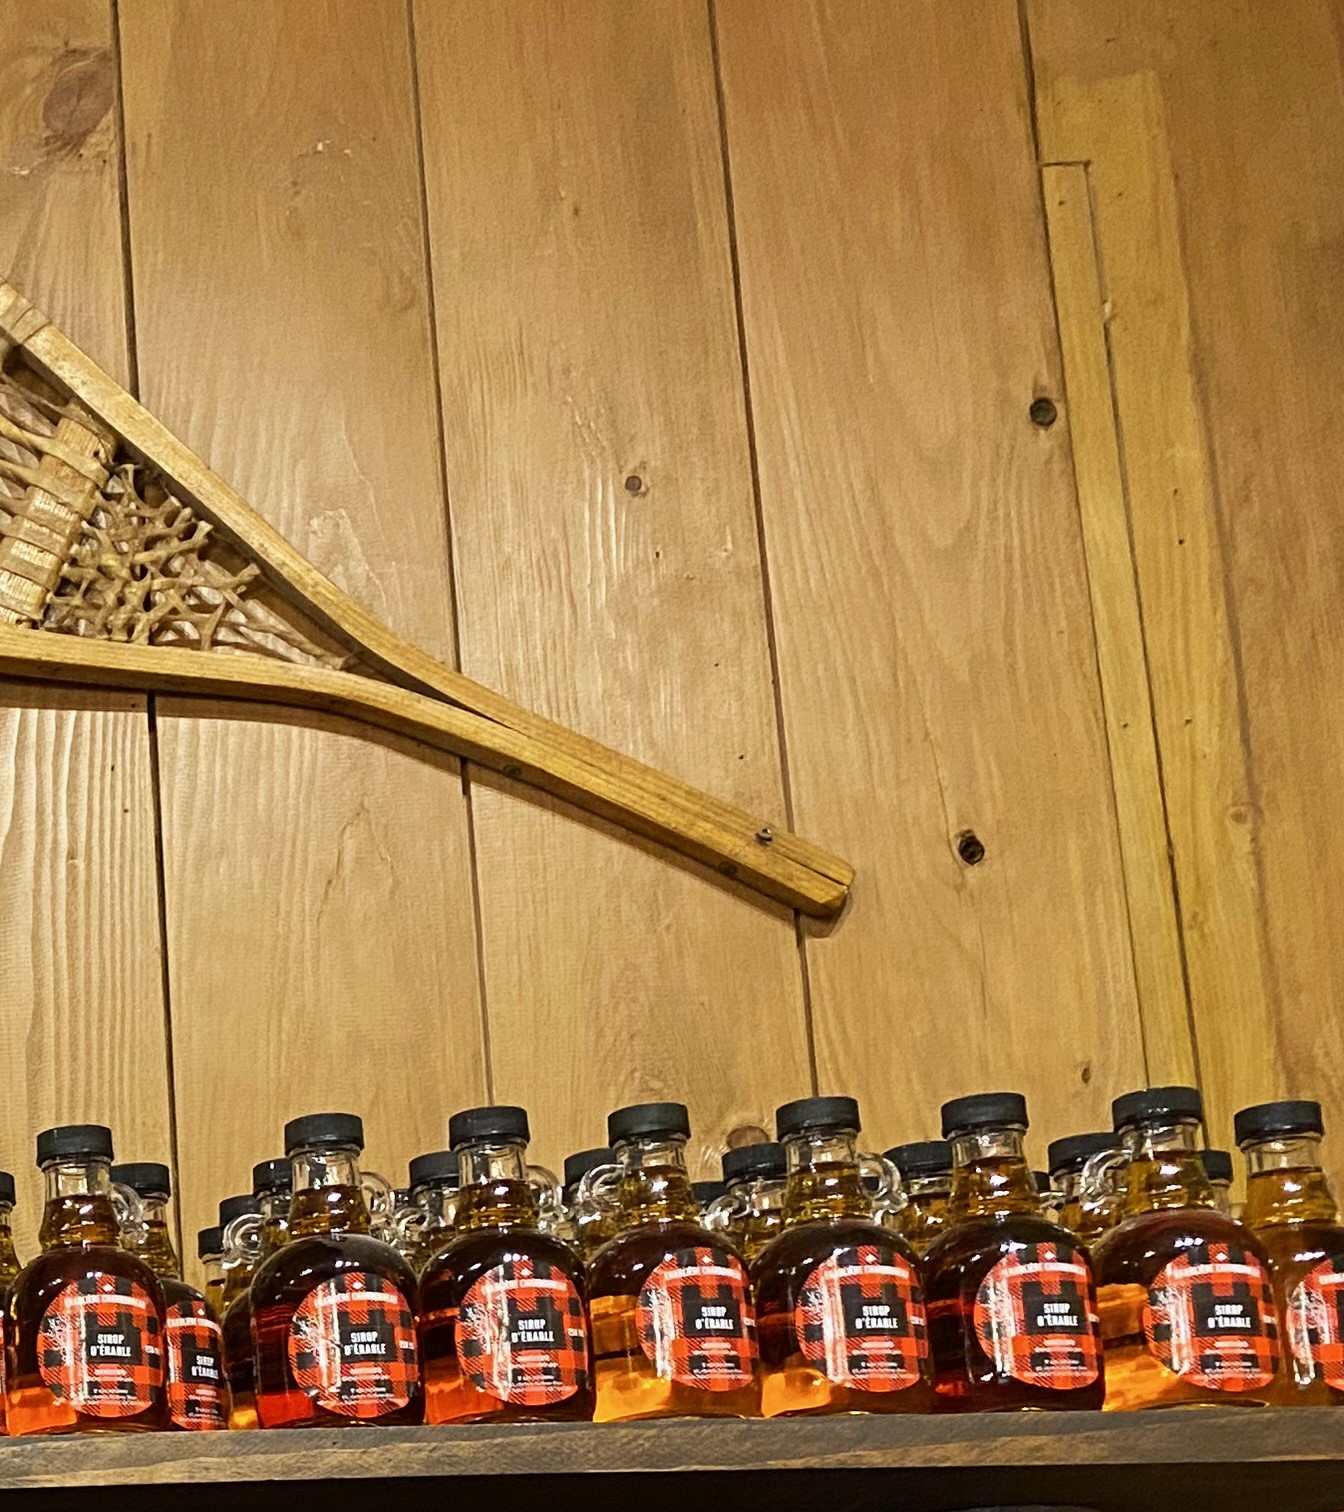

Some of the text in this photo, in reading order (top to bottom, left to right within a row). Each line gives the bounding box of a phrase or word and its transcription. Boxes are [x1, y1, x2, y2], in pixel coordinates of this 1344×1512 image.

[701, 1306, 726, 1318] SIROP
[862, 1305, 890, 1317] SIROP
[1044, 1302, 1070, 1315] SIROP
[518, 1318, 545, 1330] SIROP
[97, 1333, 124, 1345] SIROP
[350, 1331, 378, 1343] SIROP
[90, 1344, 131, 1358] D'ÉRABLE
[344, 1342, 386, 1356] D'ÉRABLE
